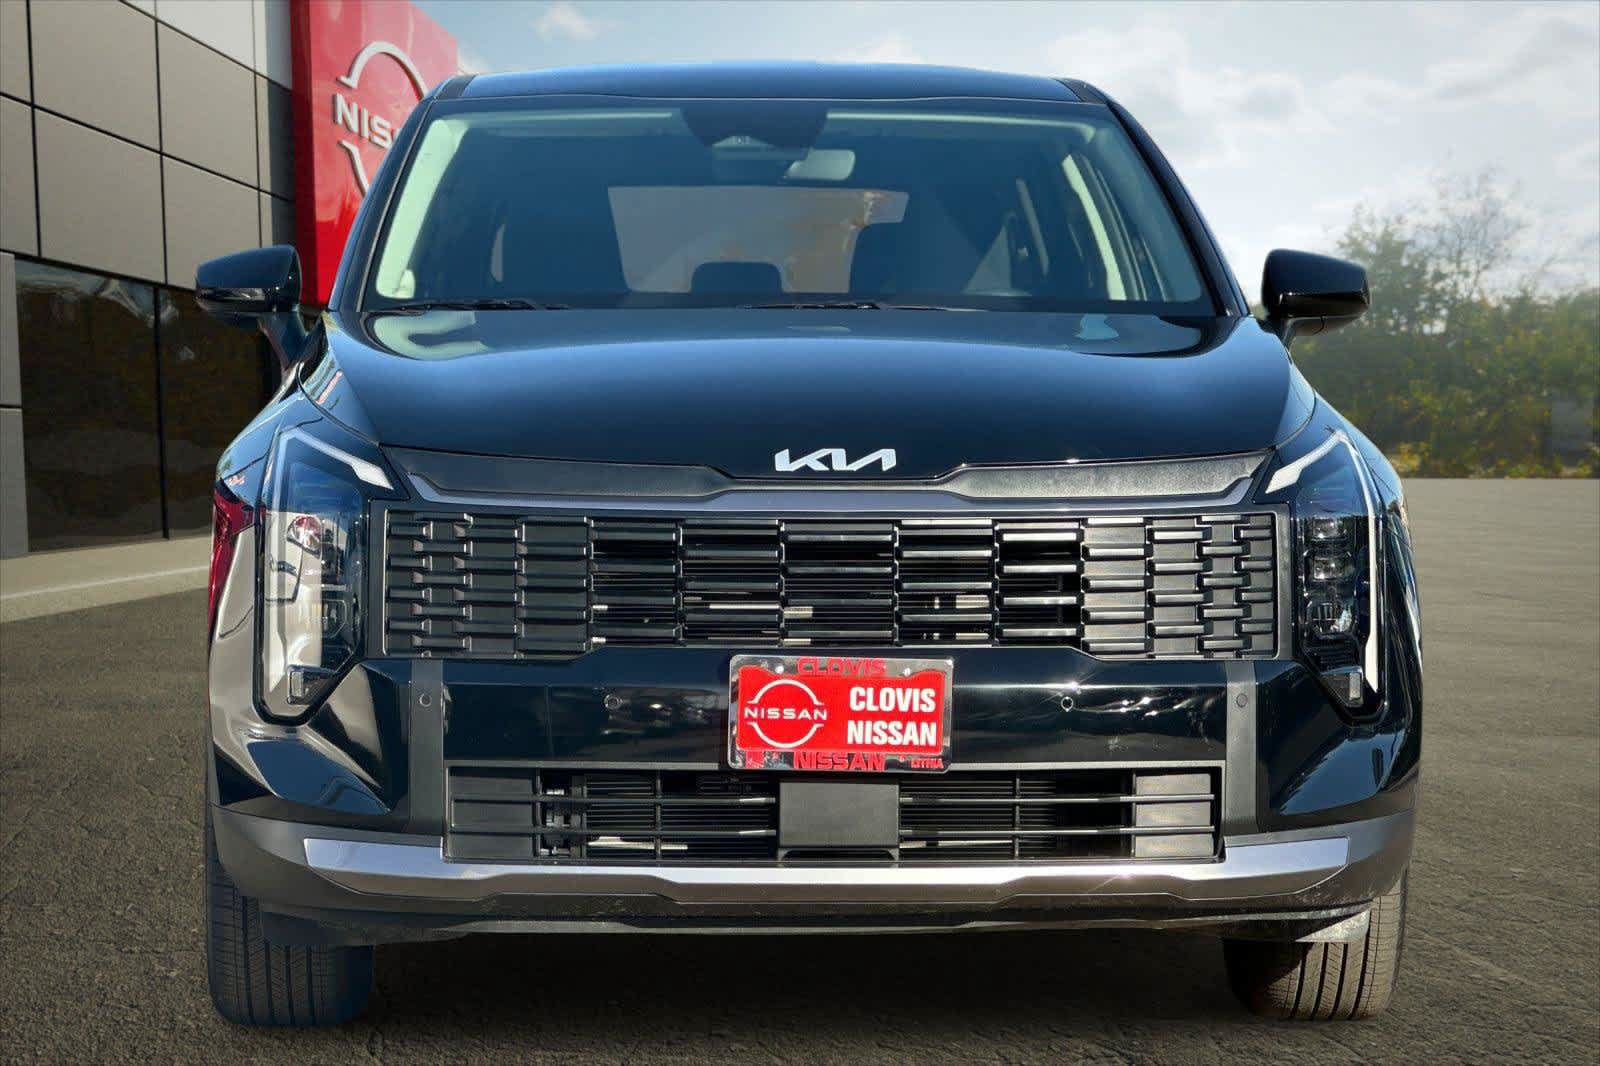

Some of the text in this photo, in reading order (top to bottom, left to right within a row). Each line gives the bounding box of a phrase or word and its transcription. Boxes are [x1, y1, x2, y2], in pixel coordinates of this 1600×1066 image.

[333, 92, 401, 149] NIS
[774, 448, 897, 472] KIA
[797, 658, 886, 675] CLOVIS
[849, 687, 936, 713] CLOVIS
[744, 707, 828, 721] NISSAN
[847, 720, 937, 746] NISSAN
[793, 752, 885, 771] NISSAN
